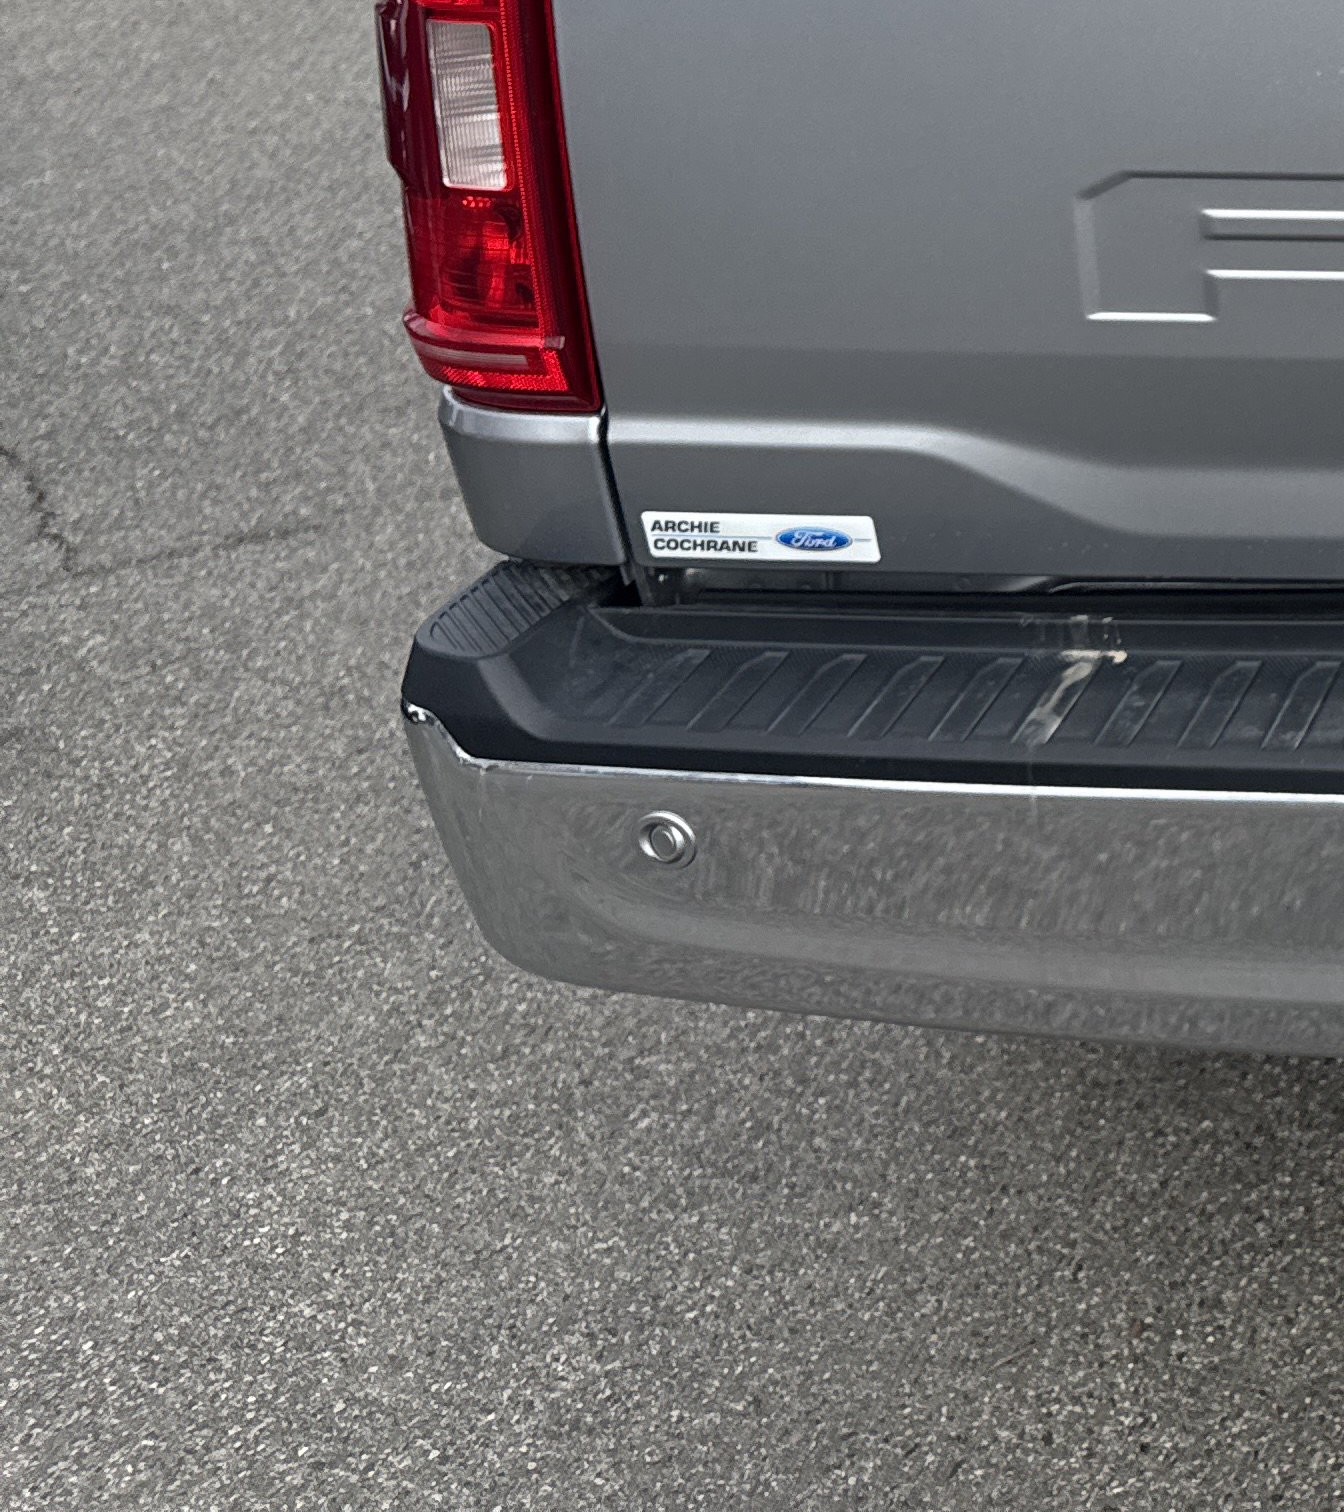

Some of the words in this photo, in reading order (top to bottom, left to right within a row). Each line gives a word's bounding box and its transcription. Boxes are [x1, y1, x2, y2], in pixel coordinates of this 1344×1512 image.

[651, 519, 720, 533] ARCHIE
[653, 538, 758, 552] COCHRANE
[790, 529, 838, 548] Ford
